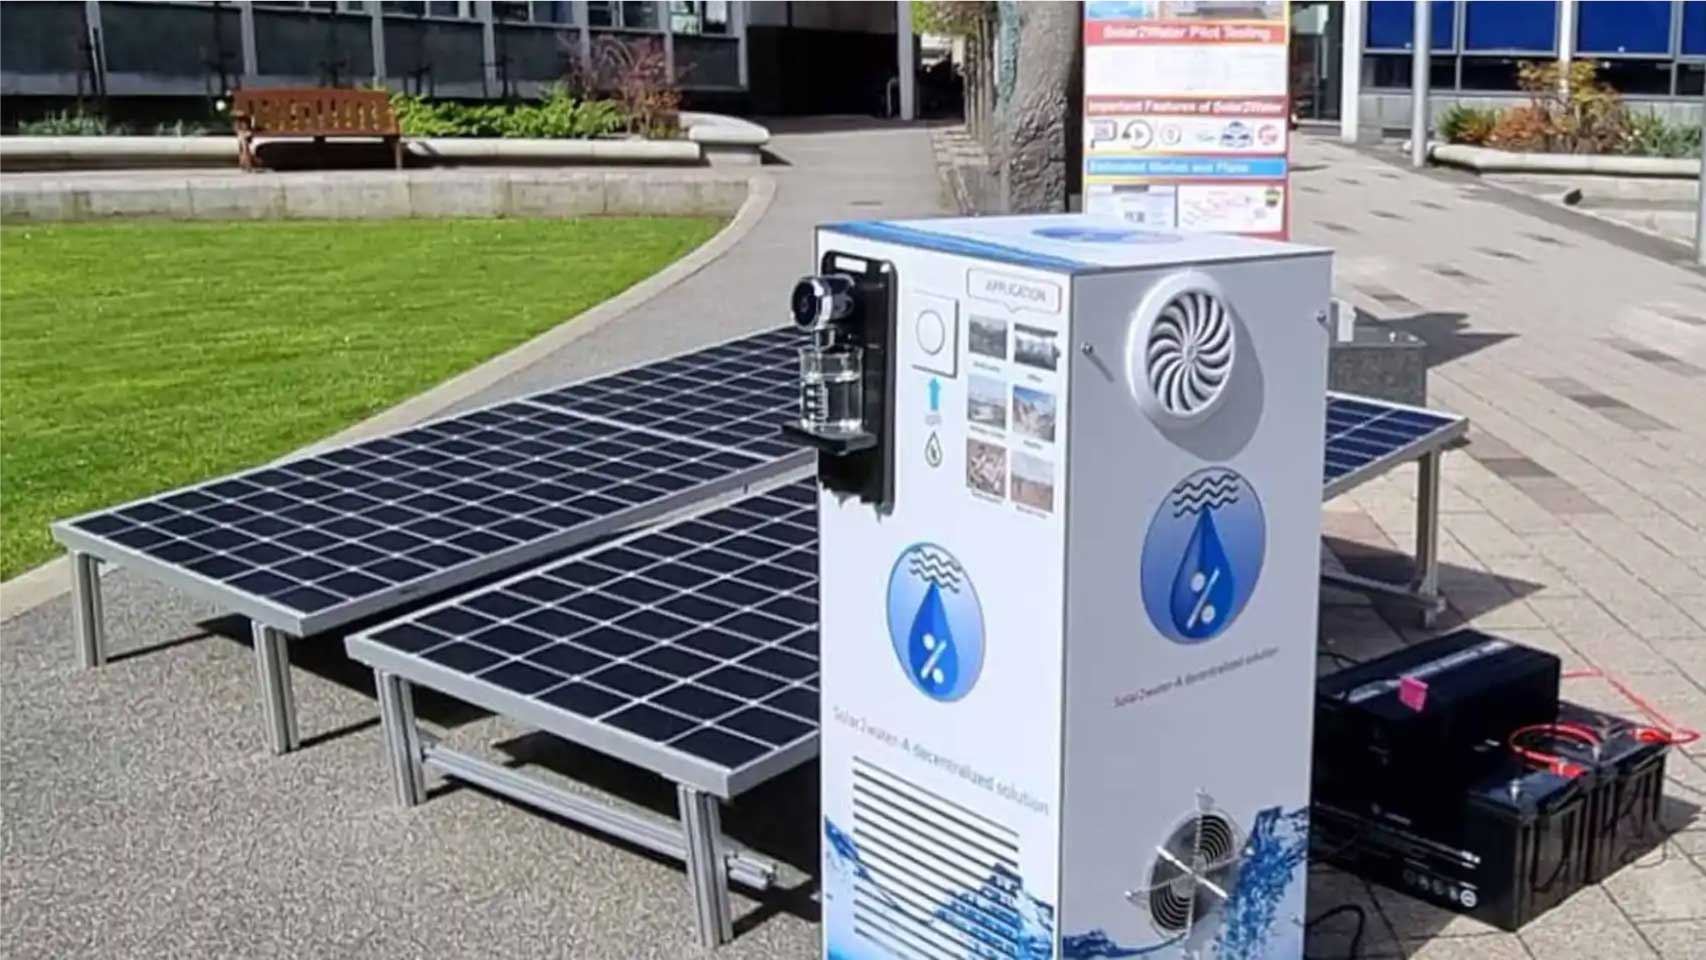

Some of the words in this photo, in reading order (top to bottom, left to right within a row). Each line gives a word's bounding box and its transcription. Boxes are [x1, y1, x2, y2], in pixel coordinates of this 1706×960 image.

[1144, 101, 1196, 113] Features
[1198, 101, 1211, 113] of
[985, 280, 1046, 301] APPLICATION
[1185, 658, 1244, 685] decentralized
[1246, 647, 1279, 664] solution
[913, 743, 995, 792] decentralized
[995, 781, 1050, 816] solution
